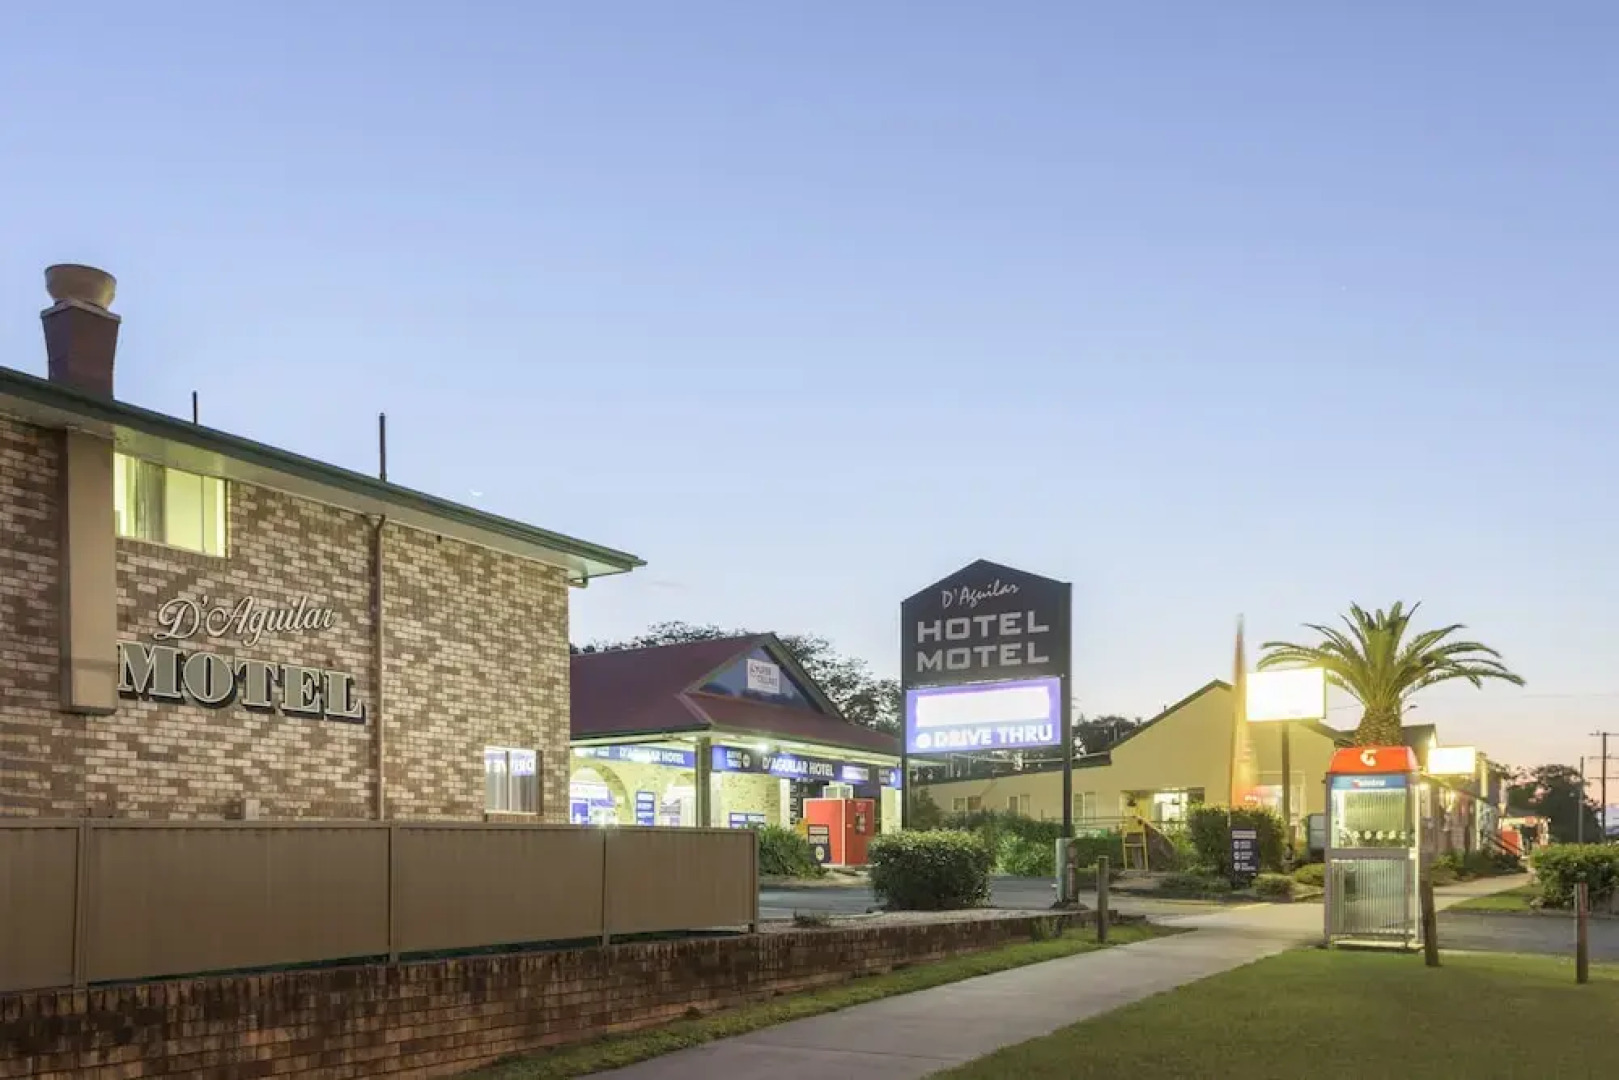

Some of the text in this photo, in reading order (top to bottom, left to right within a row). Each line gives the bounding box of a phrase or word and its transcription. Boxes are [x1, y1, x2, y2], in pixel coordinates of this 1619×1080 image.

[942, 579, 1020, 609] D'Aguilar
[153, 595, 336, 647] D'Aguilar
[917, 610, 1050, 644] HOTEL
[916, 642, 1050, 673] MOTEL
[117, 640, 365, 721] MOTEL
[934, 723, 1053, 748] DRIVE THRU
[762, 754, 808, 776] D'AGUILAR
[809, 761, 834, 777] HOTEL
